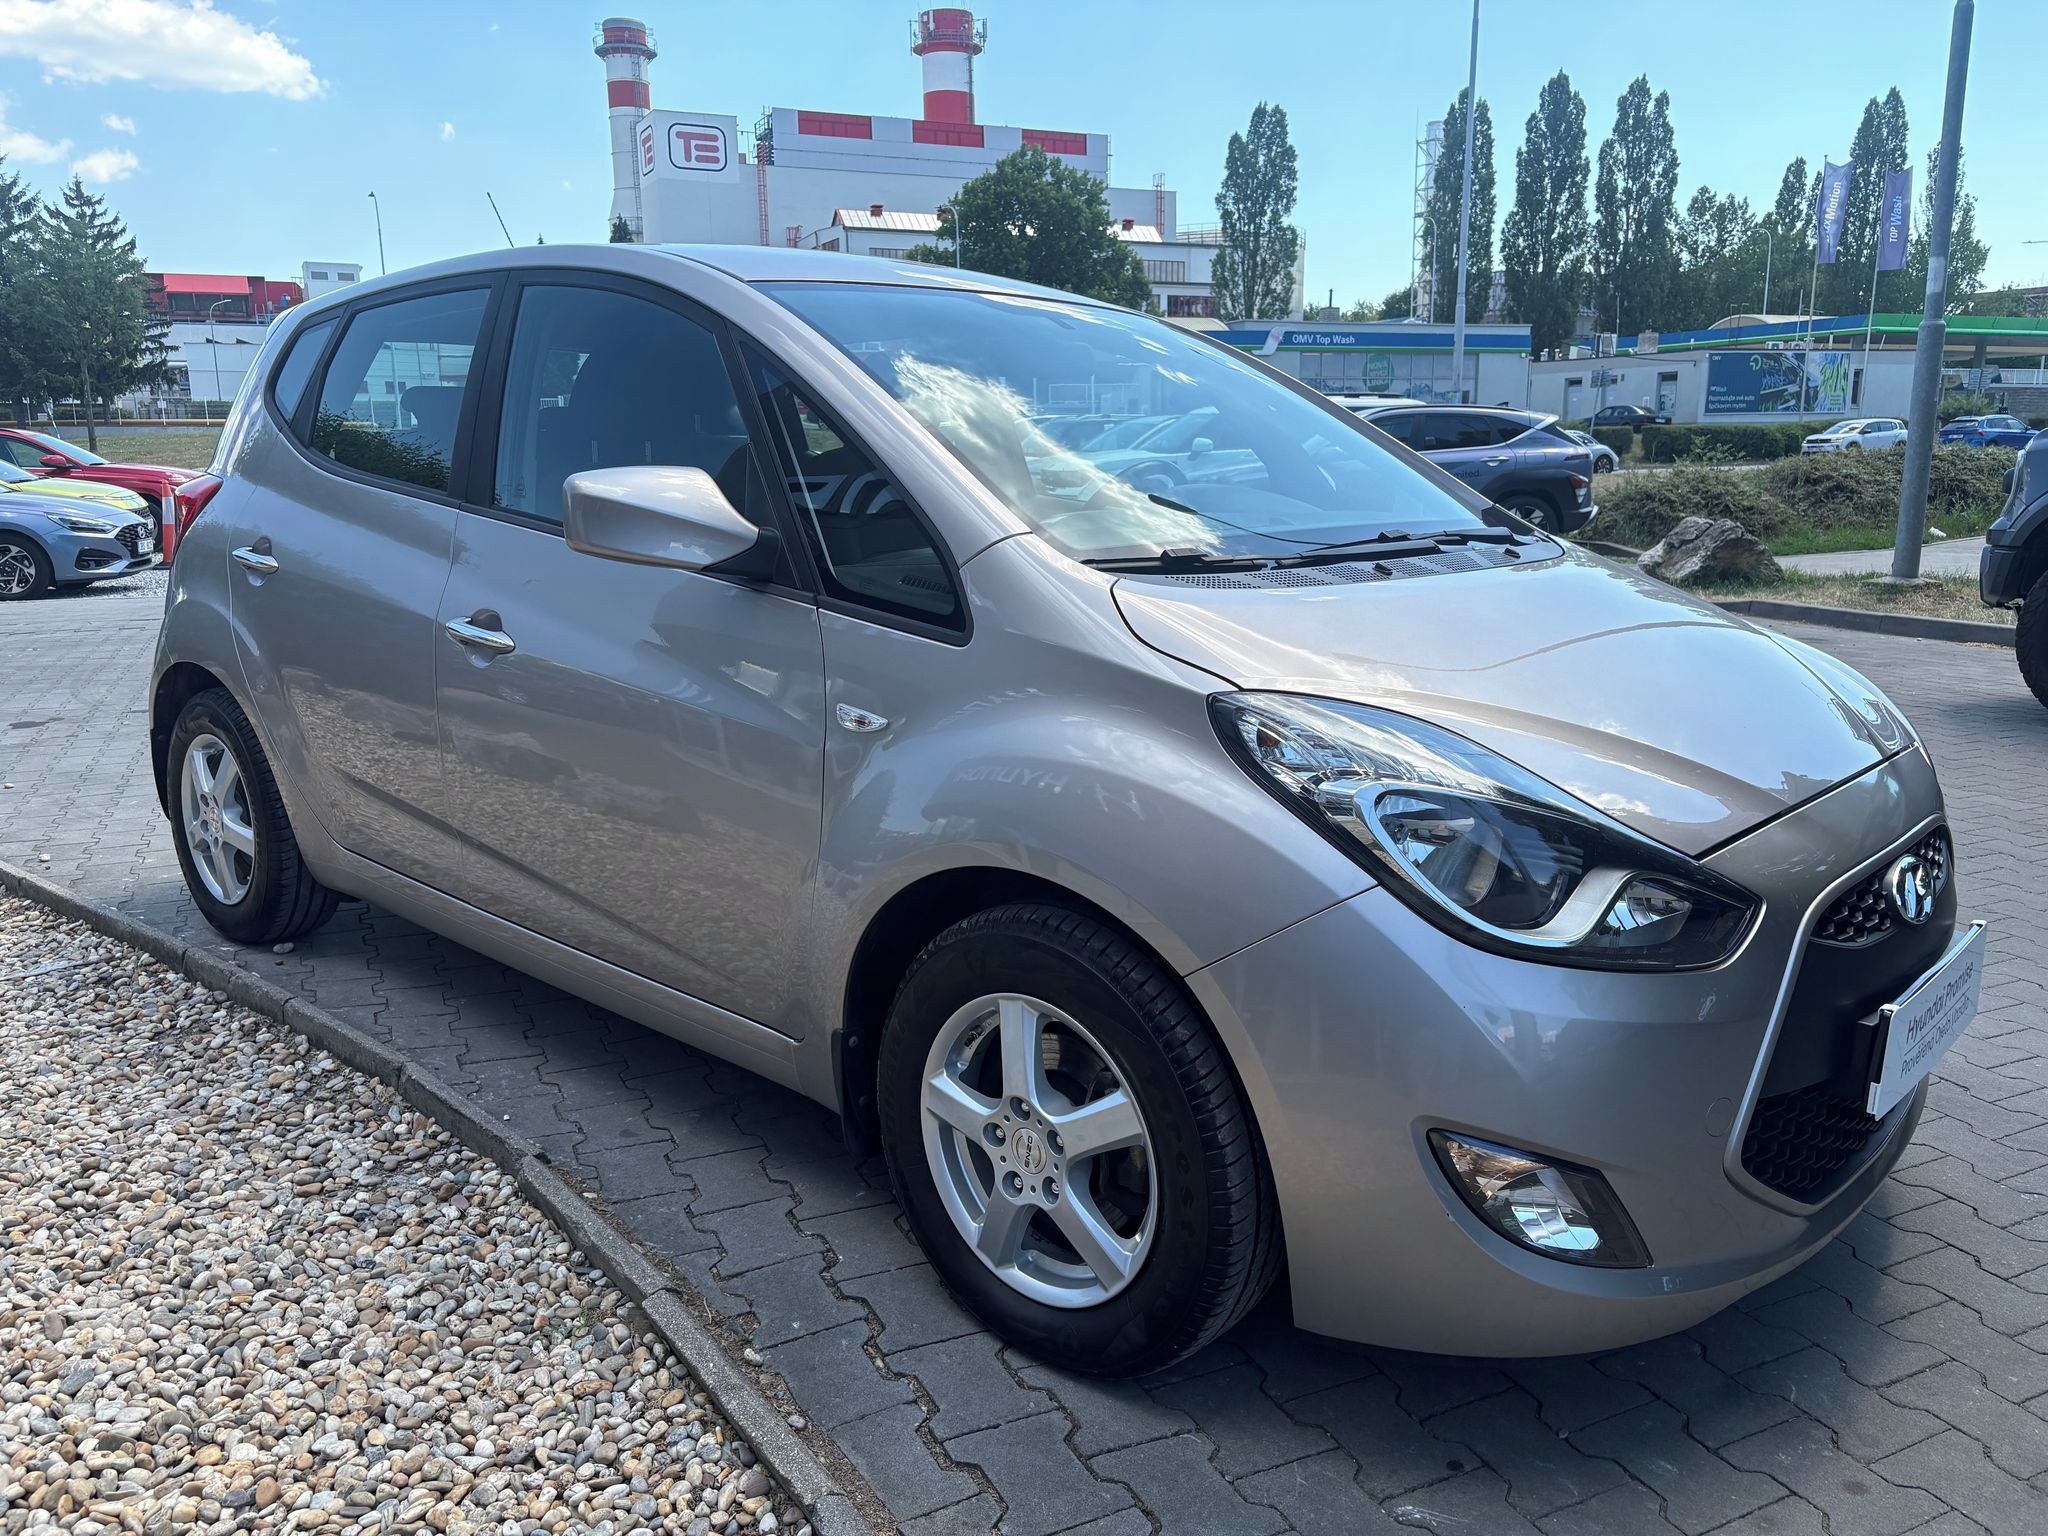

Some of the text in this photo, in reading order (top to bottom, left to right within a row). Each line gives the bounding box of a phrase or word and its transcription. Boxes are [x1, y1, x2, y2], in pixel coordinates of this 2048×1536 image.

[1889, 195, 1902, 243] TOP Wash
[1292, 334, 1355, 346] OMV Top Wash
[1905, 962, 1974, 1045] Hyundai Promise
[1024, 1135, 1033, 1169] ENZO
